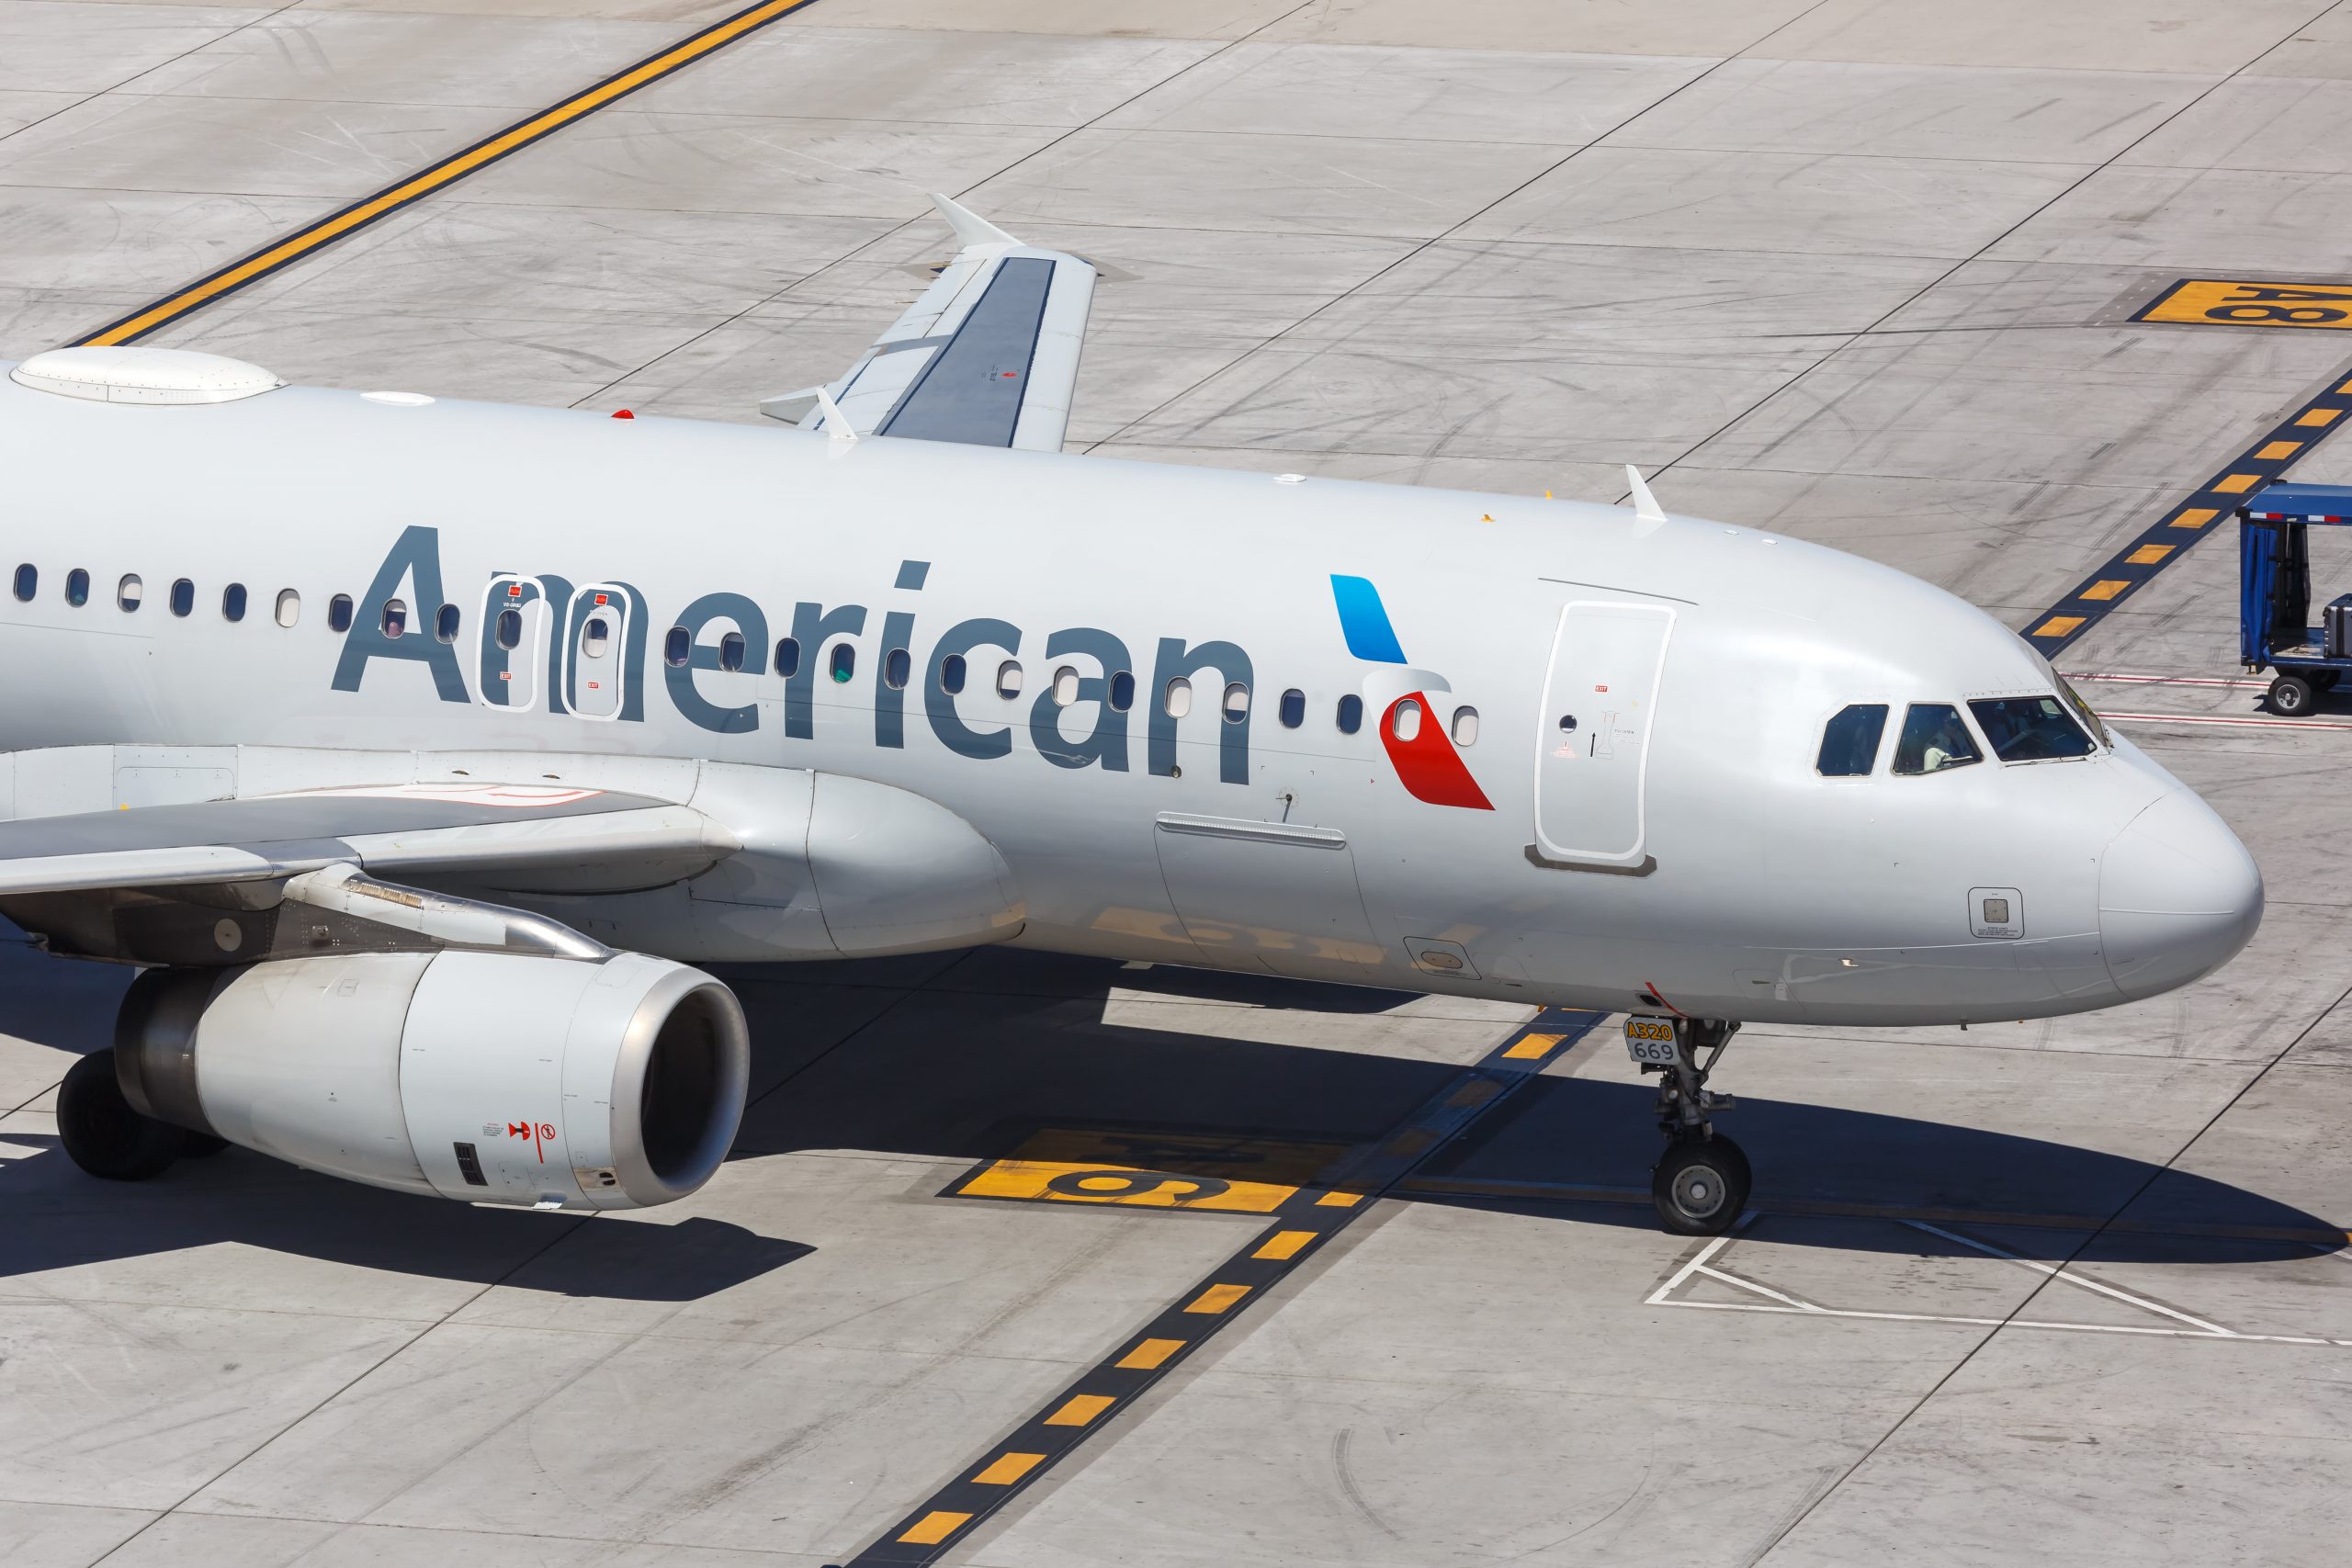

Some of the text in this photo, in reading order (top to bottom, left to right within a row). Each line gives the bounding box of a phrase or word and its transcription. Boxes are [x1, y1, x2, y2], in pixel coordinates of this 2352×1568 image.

[2204, 286, 2352, 323] A8
[332, 525, 1253, 784] American
[1627, 1021, 1673, 1041] A320
[1634, 1043, 1674, 1060] 669
